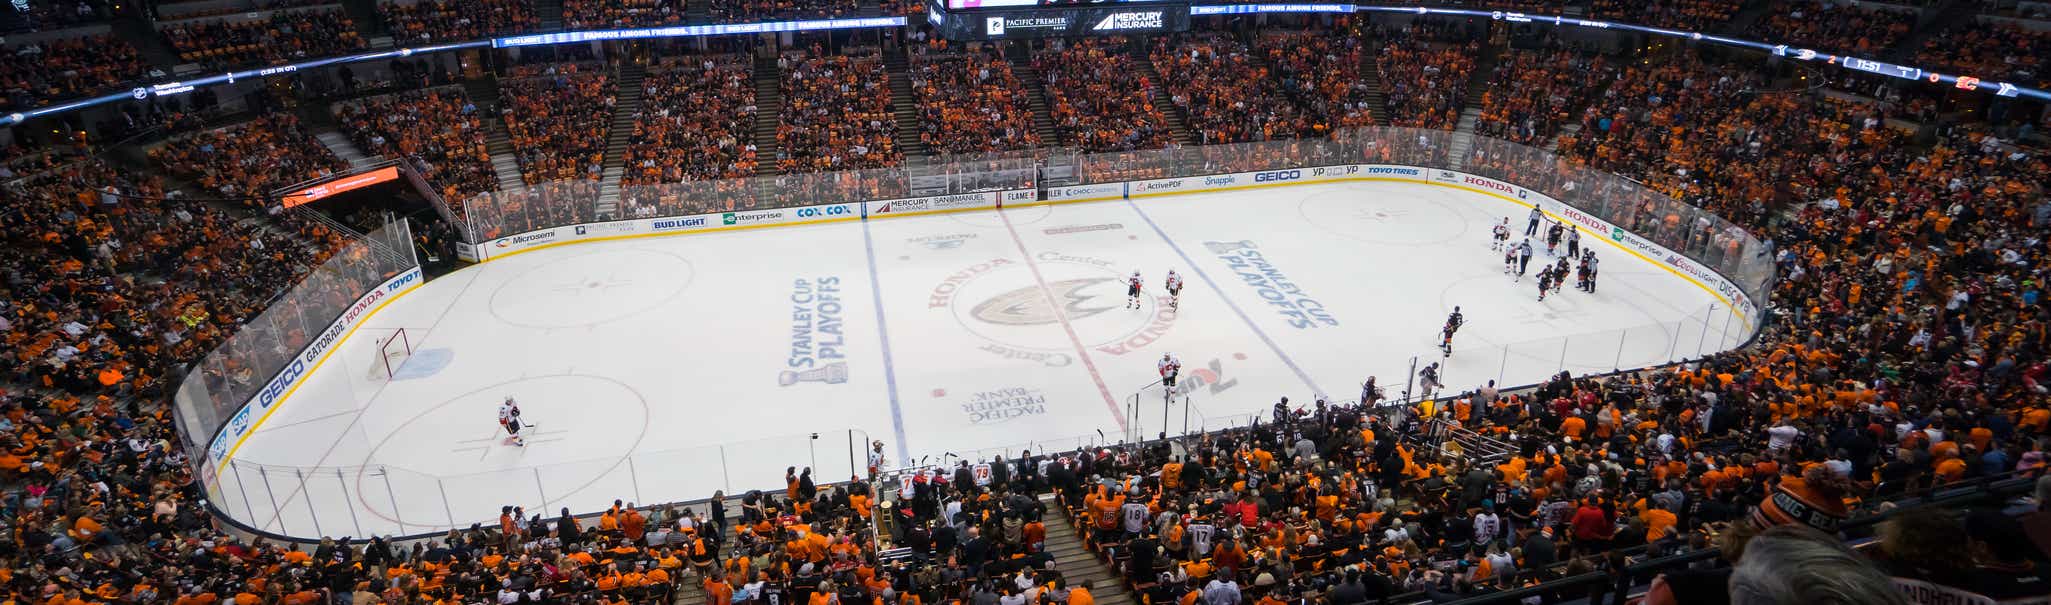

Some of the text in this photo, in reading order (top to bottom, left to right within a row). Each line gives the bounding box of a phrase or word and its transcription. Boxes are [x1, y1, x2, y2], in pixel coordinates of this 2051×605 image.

[1006, 17, 1066, 27] PACIFIC PREMIER
[1114, 12, 1162, 22] MERCURY
[1114, 20, 1162, 29] INSURANCE
[584, 31, 619, 39] FAMOUS
[620, 30, 650, 38] AMONG
[1828, 56, 1836, 64] 2
[153, 82, 181, 91] Toronto
[155, 85, 194, 97] Washington
[1255, 170, 1300, 182] GEICO
[1393, 168, 1419, 176] TIRES
[1147, 181, 1182, 190] ActivePDF
[1205, 176, 1235, 185] Snapple
[1464, 175, 1514, 193] HONDA
[1007, 192, 1029, 200] FLAME
[891, 199, 929, 208] MERCURY
[797, 208, 822, 218] COX
[826, 205, 851, 216] COX
[654, 218, 705, 230] BUD LIGHT
[726, 212, 782, 224] enterprise
[1563, 208, 1608, 233] HONDA
[512, 231, 556, 245] Microsemi
[1616, 230, 1663, 256] enterprise
[1238, 250, 1308, 297] STANLEY
[1697, 271, 1718, 287] LIGHT
[928, 257, 1016, 310] HONDA
[1218, 255, 1318, 329] PLAYOFFS
[345, 289, 384, 325] HONDA
[788, 278, 814, 368] STANLEY CUP
[816, 276, 845, 359] PLAYOFFS
[306, 320, 346, 362] GATORADE
[260, 359, 305, 408] GEICO
[232, 412, 250, 434] SAP
[976, 468, 988, 479] 79
[904, 478, 910, 490] 7
[1129, 509, 1140, 520] 18
[1196, 530, 1208, 543] 17
